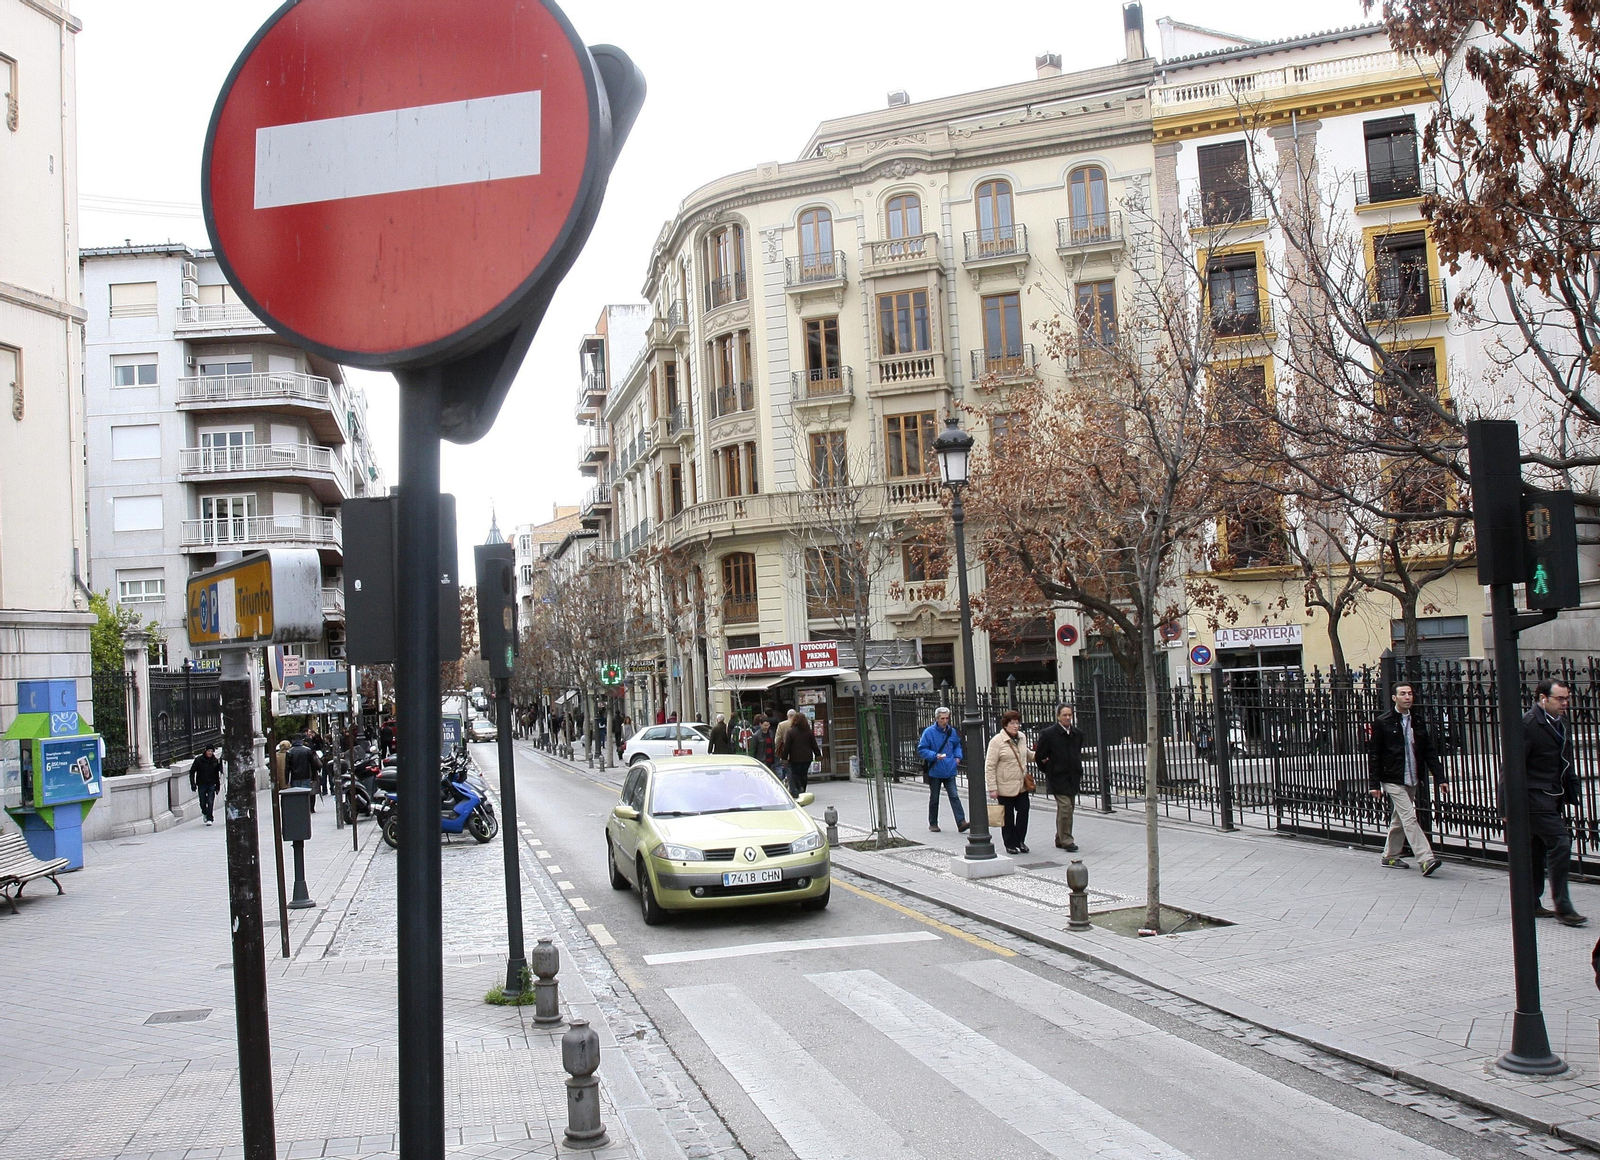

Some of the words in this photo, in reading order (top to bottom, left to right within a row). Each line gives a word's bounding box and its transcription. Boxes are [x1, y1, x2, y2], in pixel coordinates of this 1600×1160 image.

[238, 582, 270, 617] Triunfo
[1215, 631, 1229, 642] LA
[1233, 627, 1295, 641] ESPARTERA
[800, 642, 836, 651] FOTOCOPIAS
[728, 652, 763, 671] FOTOCOPIAS
[766, 649, 793, 668] PRENSA
[806, 652, 830, 660] PRENSA
[805, 660, 834, 669] REVISTAS
[844, 682, 926, 694] FOOCOPIAS
[731, 872, 756, 884] 7418
[761, 870, 780, 881] CHN
